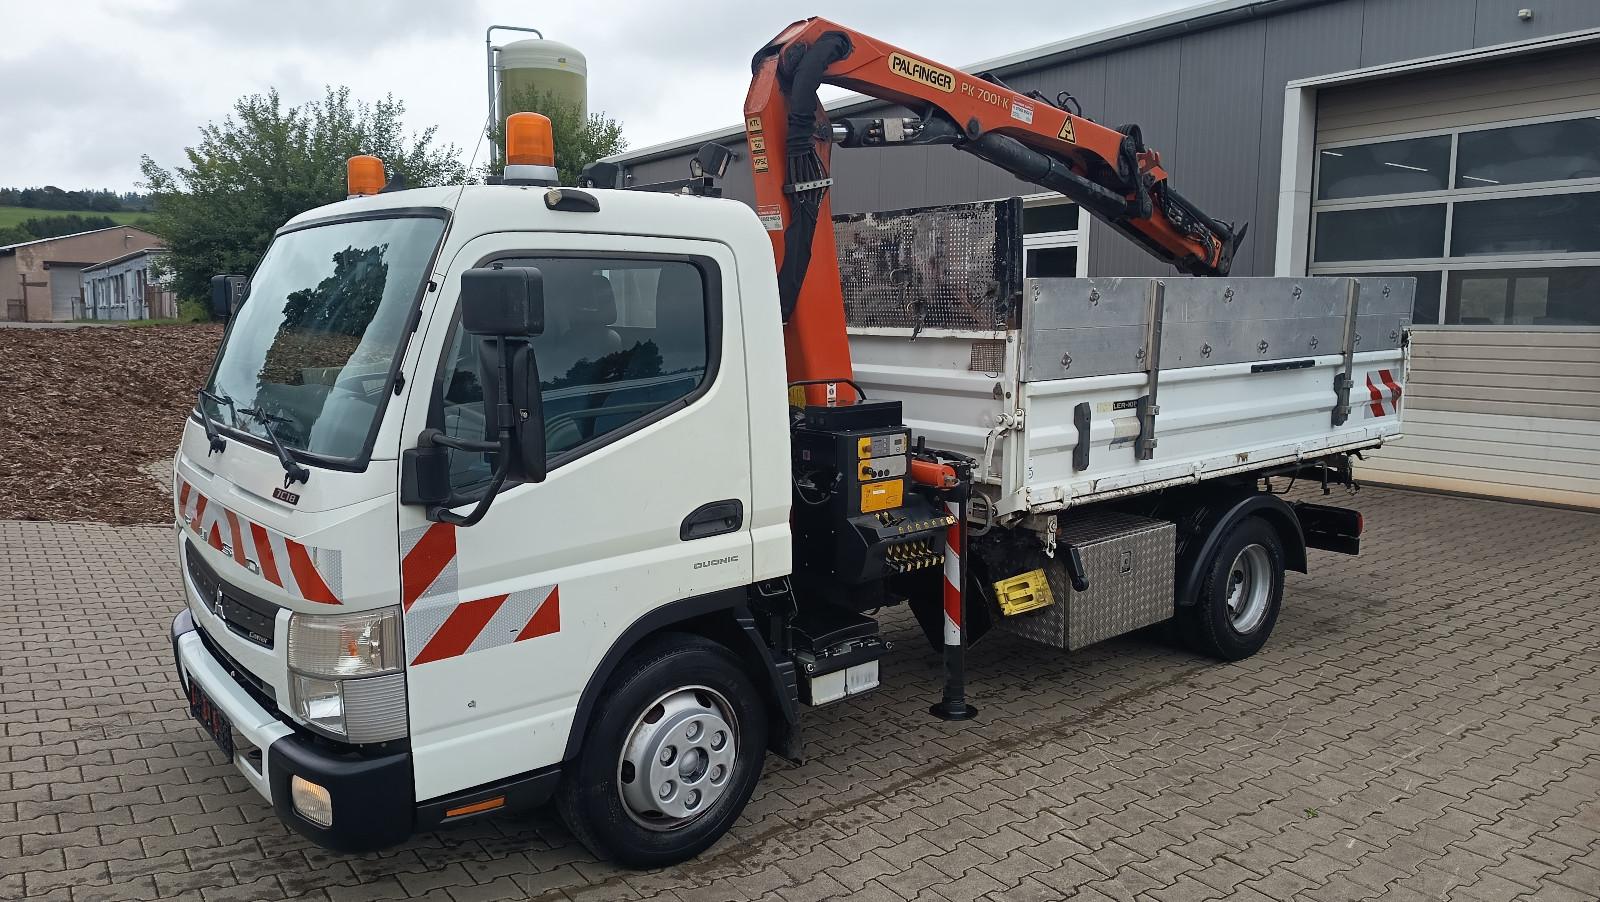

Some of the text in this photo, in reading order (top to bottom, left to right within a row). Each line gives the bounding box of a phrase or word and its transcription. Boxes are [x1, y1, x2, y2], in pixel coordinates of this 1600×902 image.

[892, 55, 952, 90] PALFINGER
[961, 82, 974, 97] PK
[276, 490, 296, 503] 7C18
[693, 555, 739, 570] DUONIC
